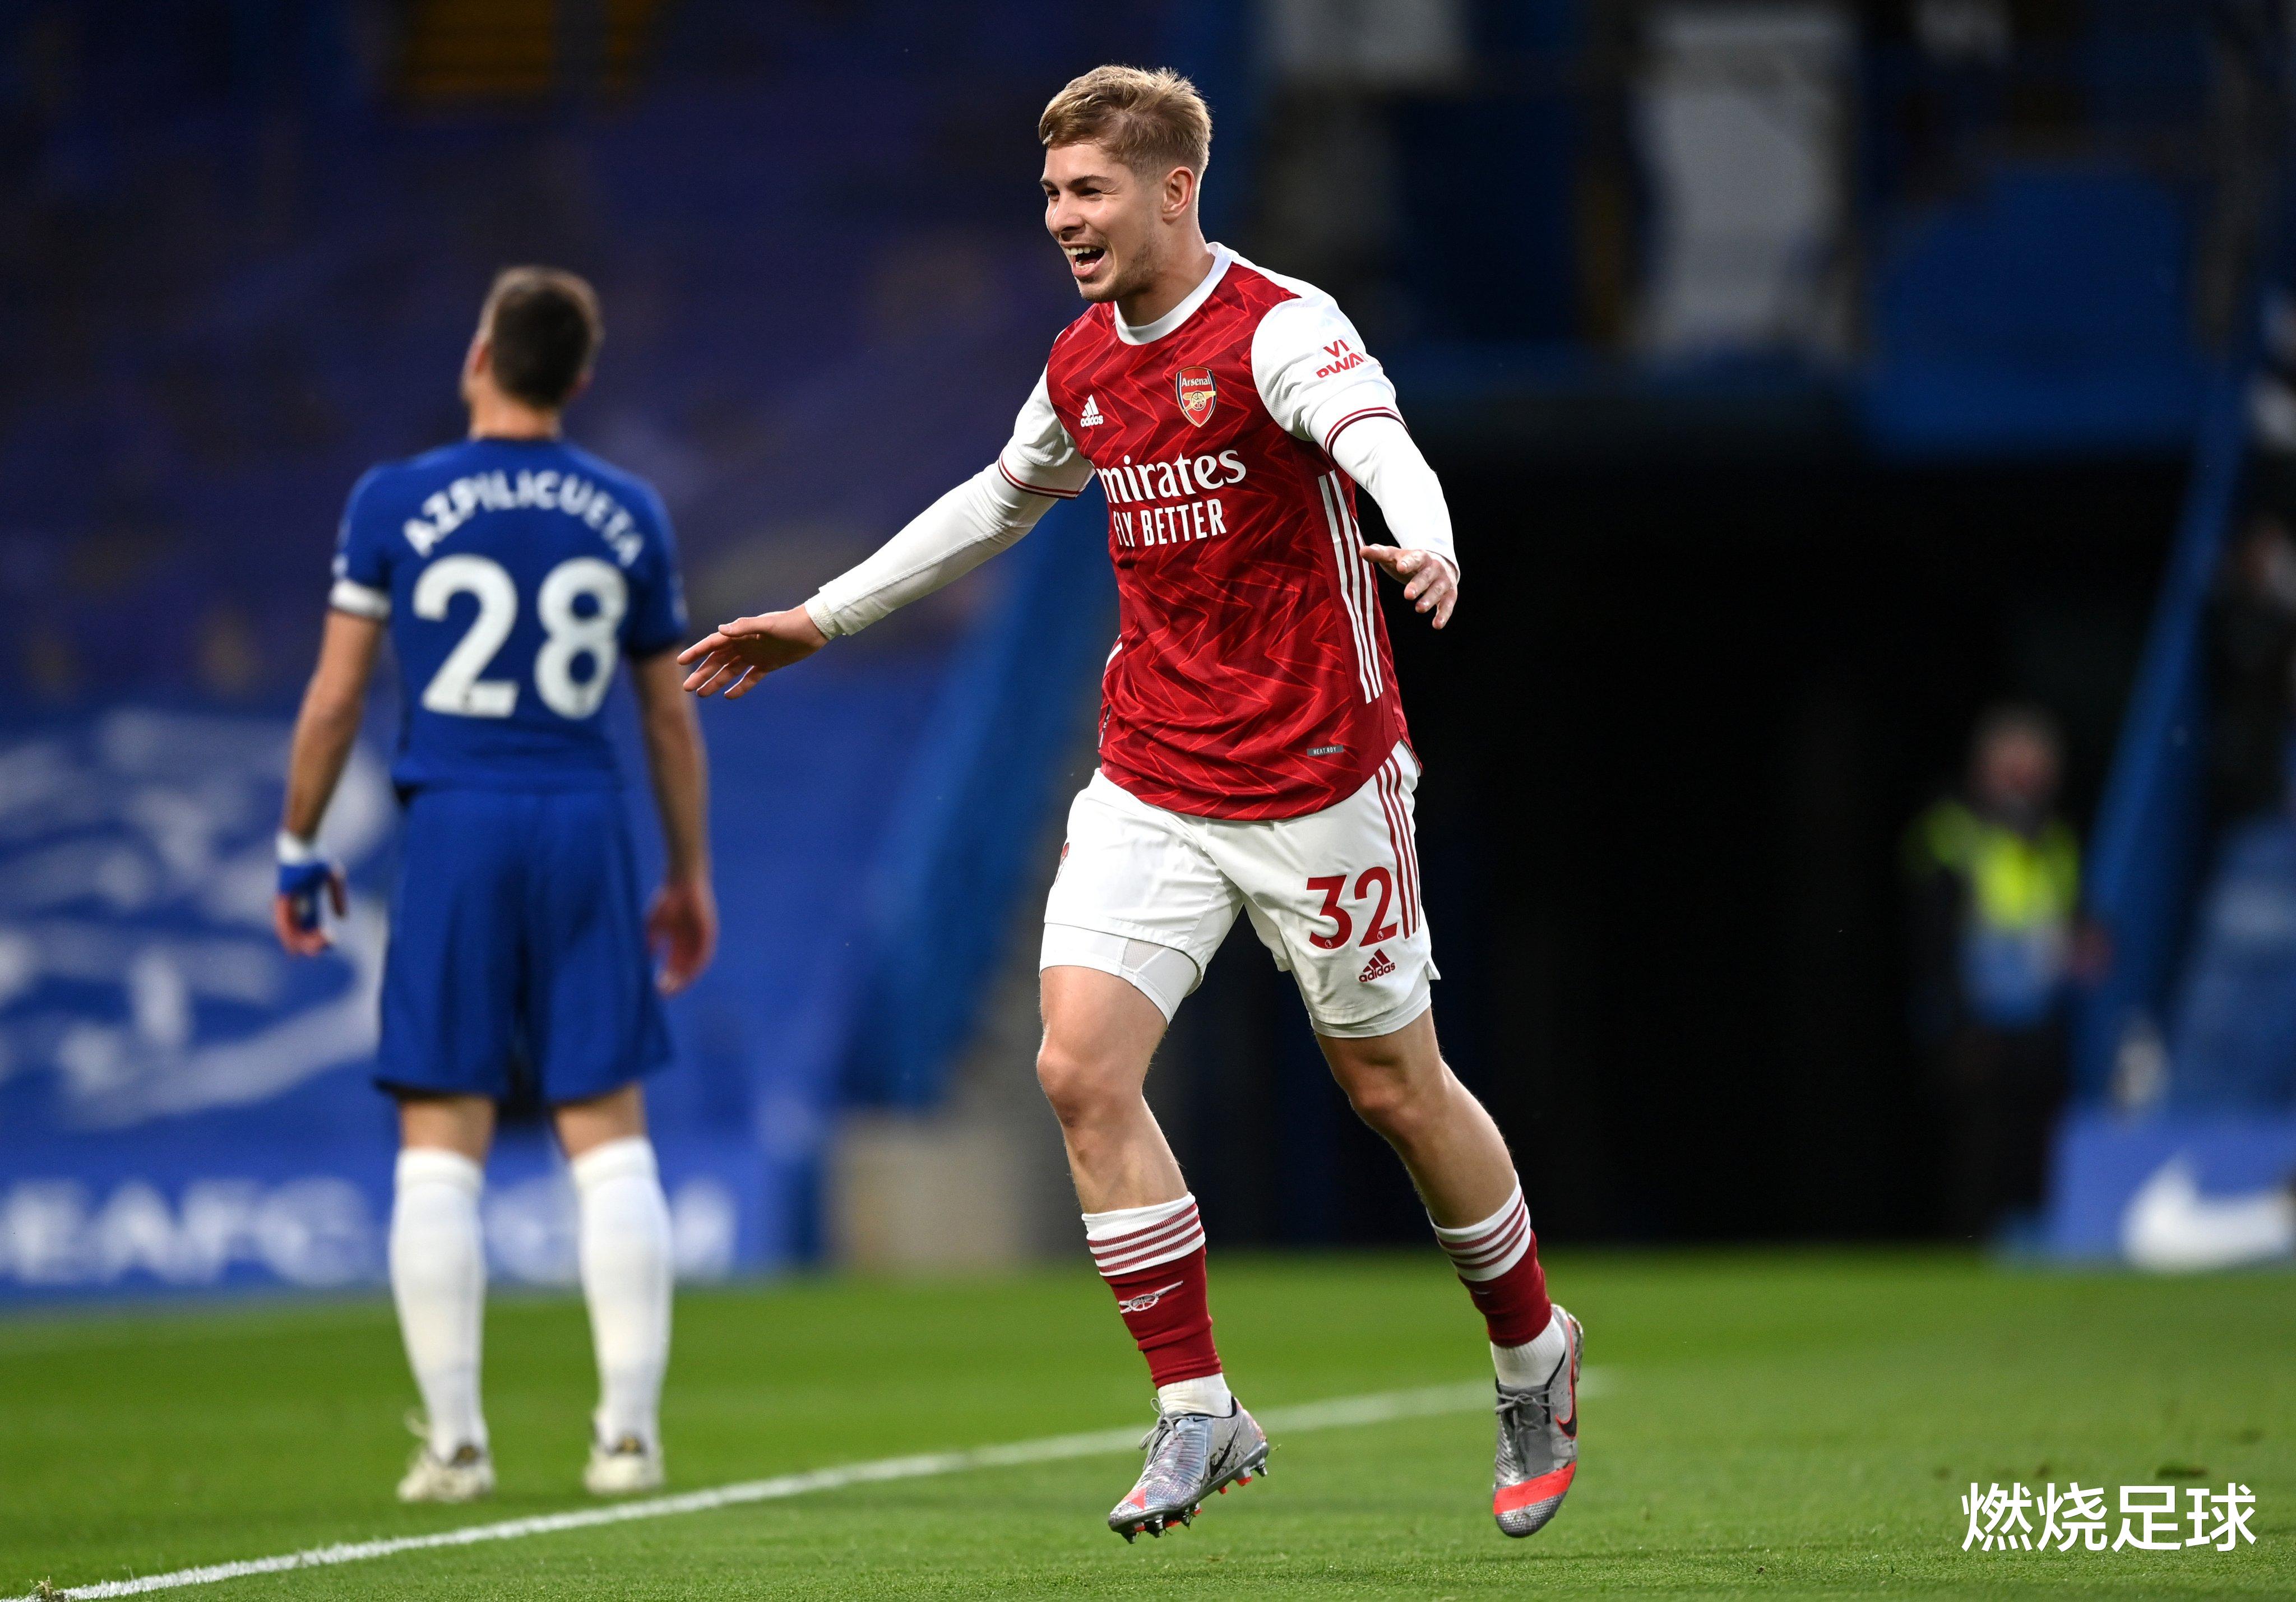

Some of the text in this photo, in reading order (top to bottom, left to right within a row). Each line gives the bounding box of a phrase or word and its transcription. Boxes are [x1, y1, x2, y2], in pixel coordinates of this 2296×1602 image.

[1181, 375, 1211, 387] Arsenal
[1080, 414, 1104, 428] adidas
[402, 468, 645, 567] AZPILICUETA
[1113, 498, 1227, 547] FLY BETTER
[413, 553, 630, 720] 28
[1313, 746, 1337, 755] HEAT.RDY
[1306, 866, 1398, 950] 32
[1358, 962, 1396, 983] adidas
